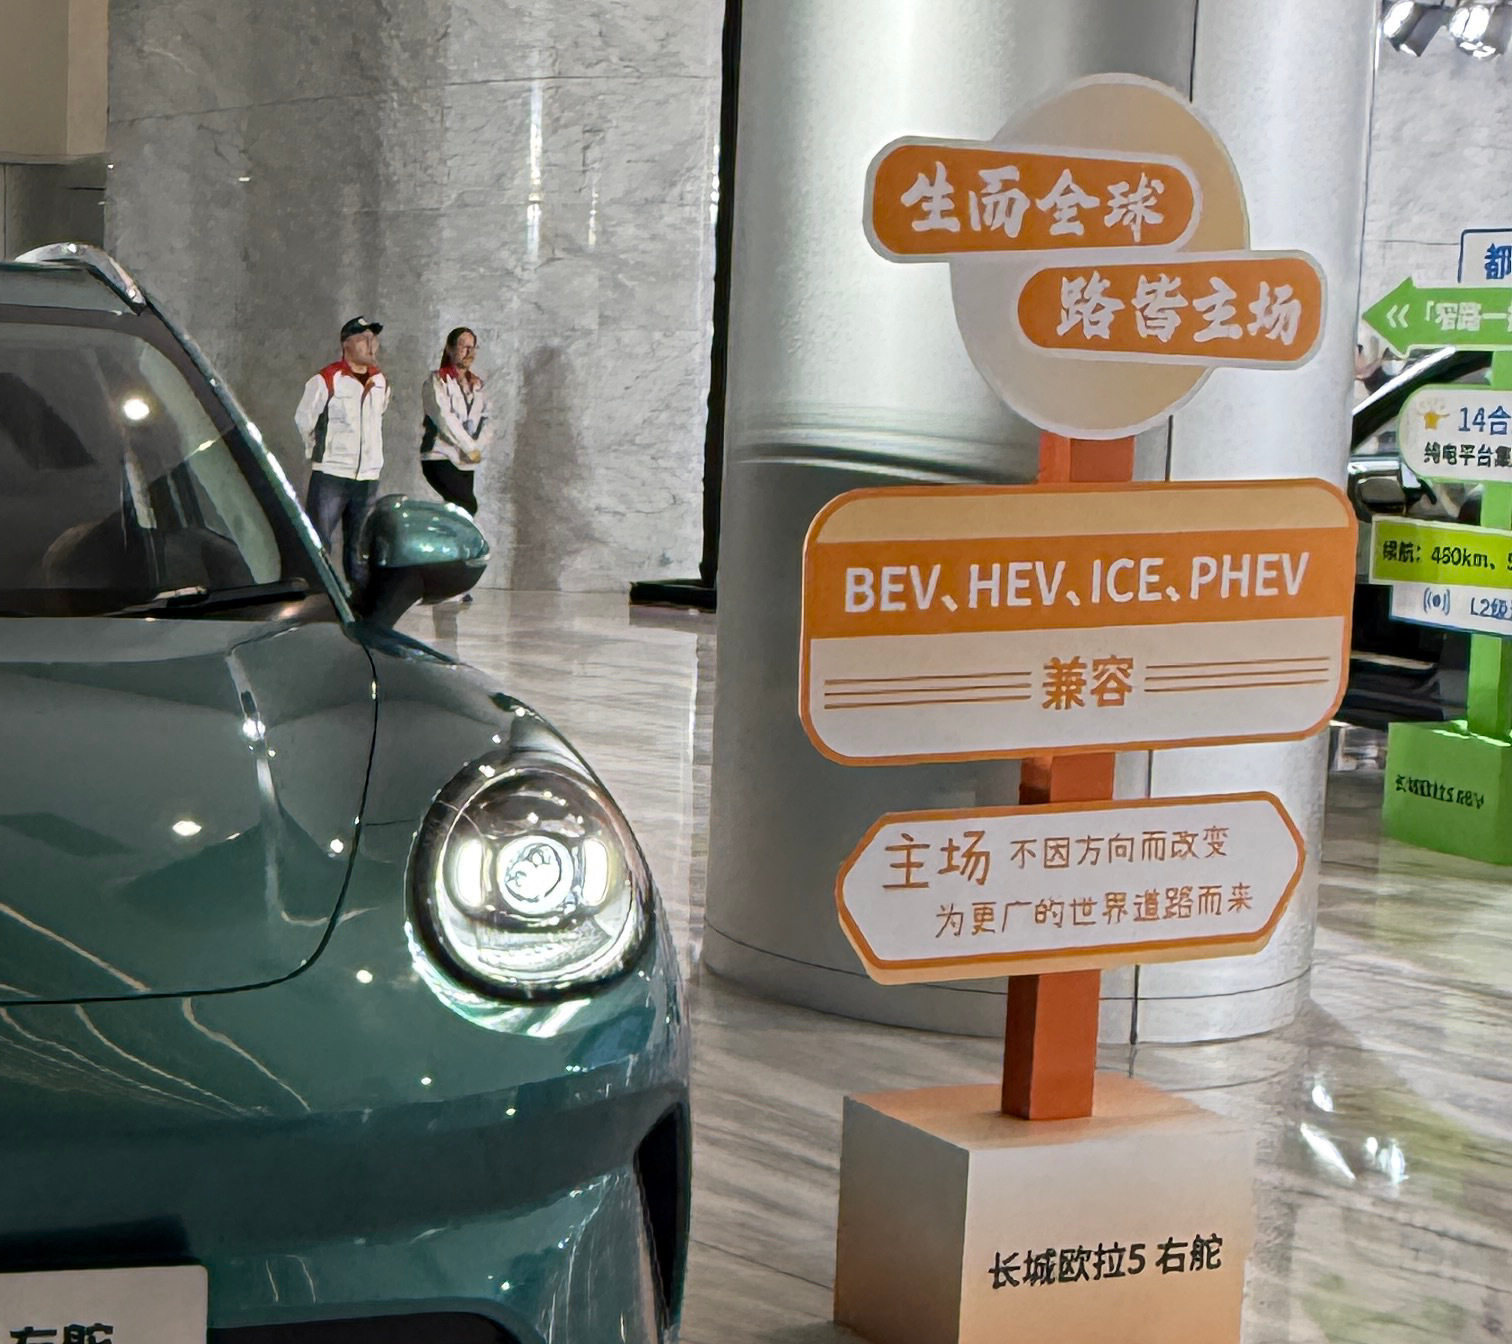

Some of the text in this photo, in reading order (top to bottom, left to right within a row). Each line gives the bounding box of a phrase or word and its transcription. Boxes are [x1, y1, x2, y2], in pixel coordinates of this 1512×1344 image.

[899, 161, 1165, 243] 生而全球
[1056, 271, 1303, 346] 路皆主场
[1470, 597, 1512, 620] L2级
[1041, 656, 1135, 711] 兼容
[882, 825, 1230, 890] 主场 不因方向而改变
[935, 882, 1255, 938] 为更广的世界道路而来
[988, 1232, 1224, 1290] 长城欧拉5 右舵
